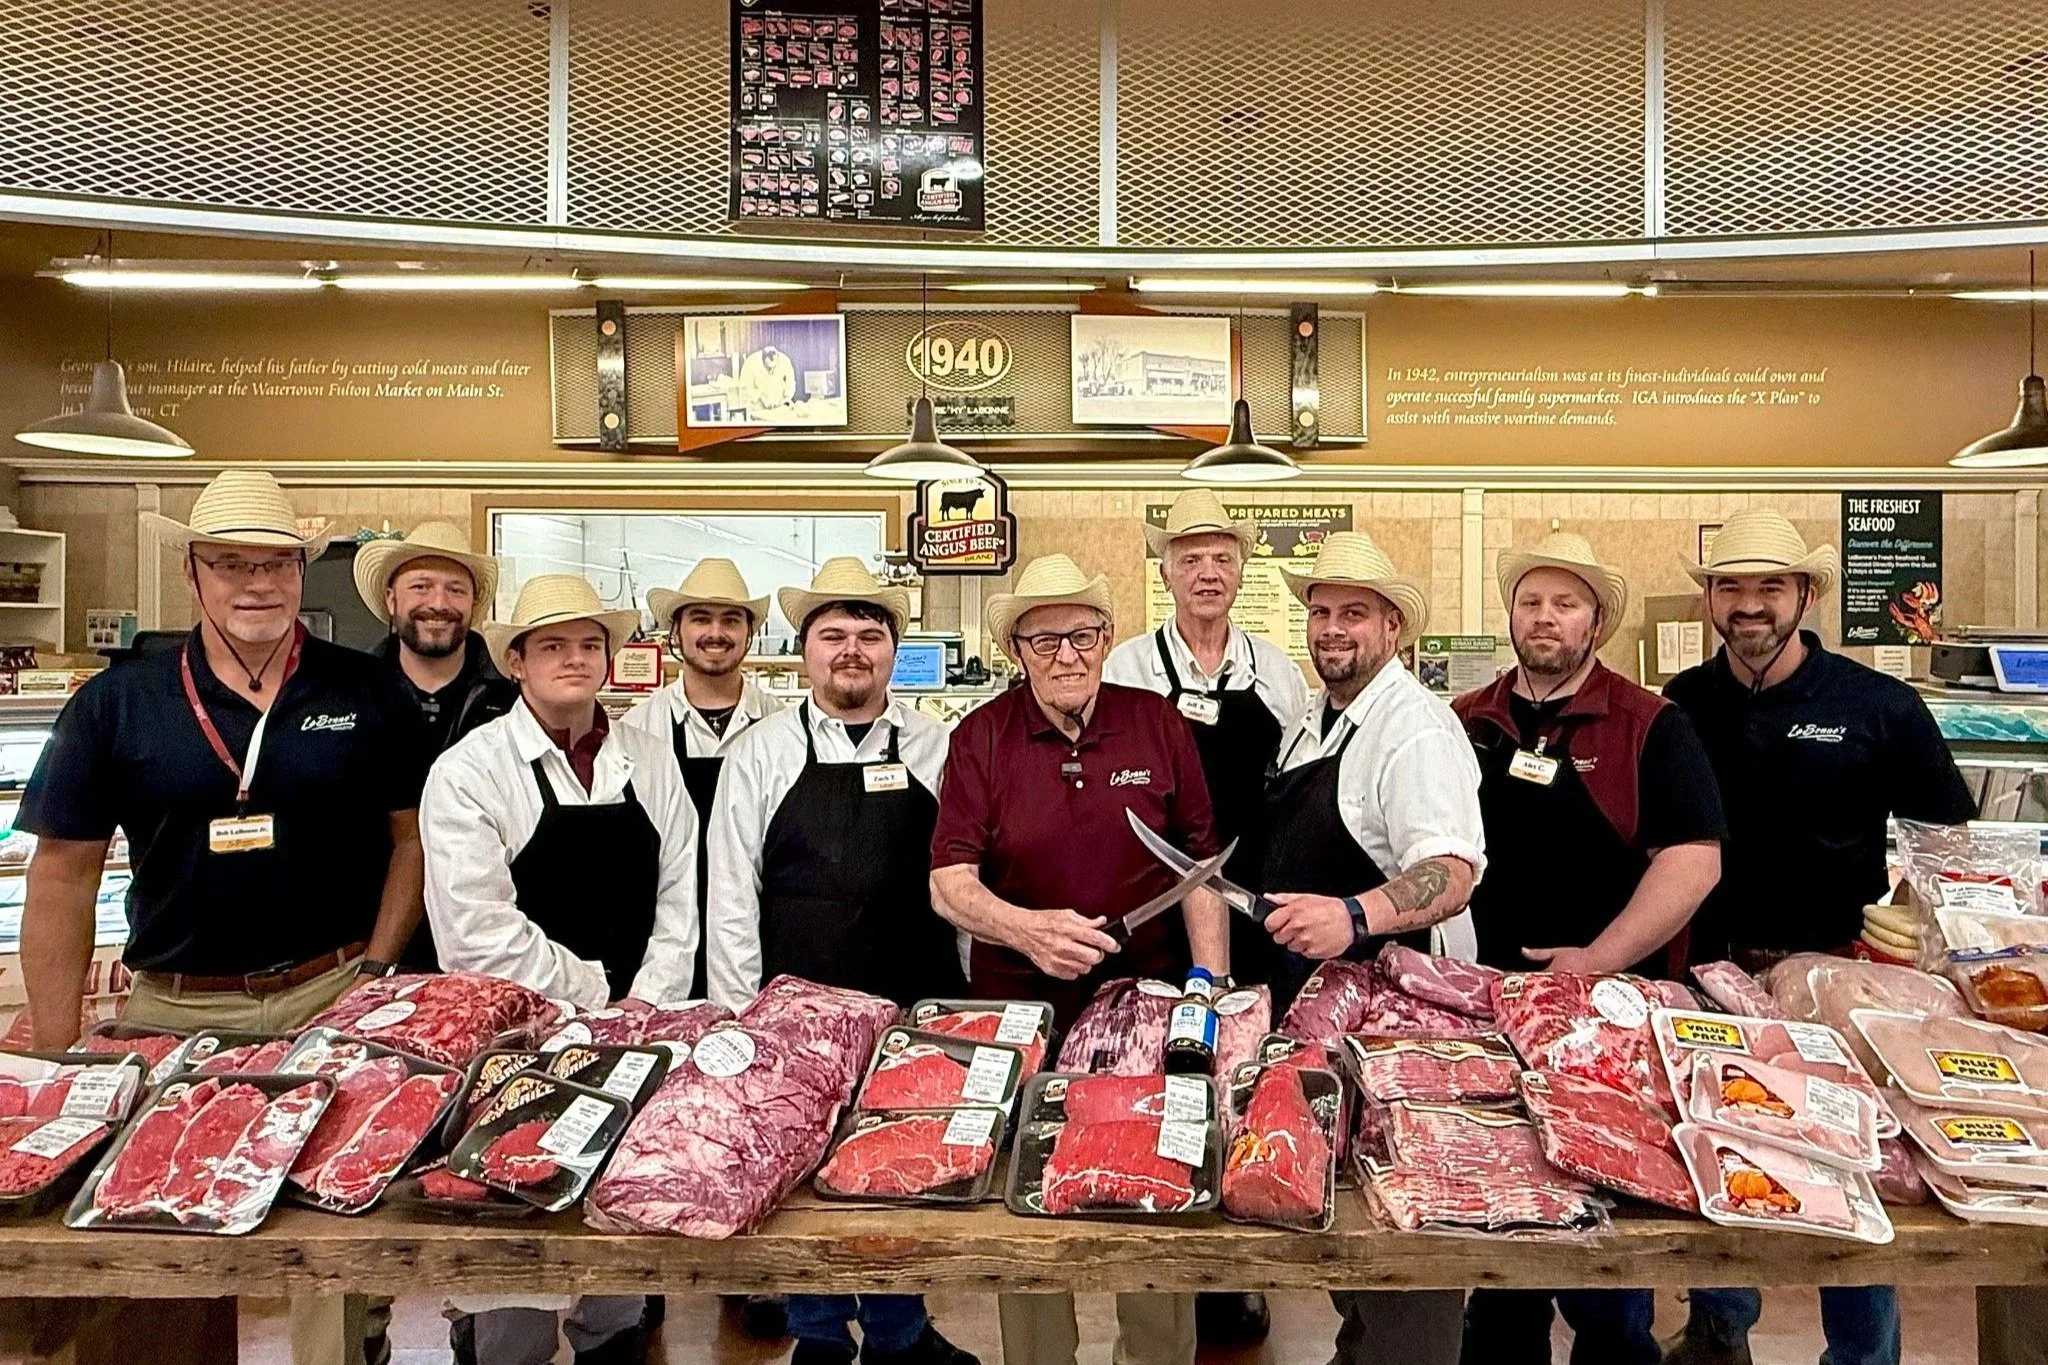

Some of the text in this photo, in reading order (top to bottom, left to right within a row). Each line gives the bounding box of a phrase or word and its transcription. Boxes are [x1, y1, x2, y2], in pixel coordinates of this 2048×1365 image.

[913, 336, 1004, 377] 1940
[168, 359, 216, 374] Hilaire,
[221, 358, 263, 378] helped
[267, 358, 285, 374] his
[283, 358, 328, 379] father
[332, 359, 349, 380] by
[352, 362, 399, 380] cutting
[402, 359, 432, 376] cold
[432, 363, 468, 376] meats
[471, 359, 499, 376] and
[501, 359, 531, 376] later
[1387, 366, 1828, 388] In 1942, entrepreneurialism was at its finest-individuals could own and
[126, 383, 143, 395] eat
[148, 383, 204, 400] manager
[208, 383, 223, 395] at
[227, 380, 247, 395] the
[252, 381, 324, 396] Watertown
[328, 380, 371, 397] Fulton
[374, 381, 425, 397] Market
[426, 385, 443, 397] on
[447, 382, 483, 398] Main
[487, 383, 505, 398] St.
[1386, 391, 1432, 408] operate
[1434, 387, 1494, 409] successful
[1487, 387, 1535, 409] family
[1538, 387, 1624, 409] supermarkets.
[1632, 390, 1659, 404] IGA
[1662, 388, 1724, 404] introduces
[1727, 388, 1747, 404] the
[1808, 391, 1821, 404] to
[967, 406, 1010, 415] LABONNE
[1386, 408, 1618, 426] assist with massive wartime demands.
[1229, 508, 1346, 519] PREPARED MEATS
[1848, 499, 1921, 514] THE FRESHEST
[1848, 517, 1896, 532] SEAFOOD
[924, 523, 996, 544] CERTIFIED
[919, 540, 968, 557] ANGUS
[1306, 545, 1321, 553] POR
[1847, 538, 1879, 548] Discover
[1880, 538, 1893, 548] the
[965, 553, 993, 563] BRAND
[301, 713, 357, 731] LaBonne's
[1787, 724, 1847, 738] LaBonne's
[1110, 769, 1151, 786] LaBonne's
[1686, 1024, 1728, 1035] VALUE
[1692, 1032, 1727, 1042] PACK
[492, 1052, 538, 1085] GRILL
[559, 1051, 600, 1080] GRILL
[1949, 1058, 1999, 1069] VALUE
[1958, 1067, 1999, 1078] PACK
[507, 1083, 556, 1111] GRILL
[1965, 1130, 2008, 1138] PACK
